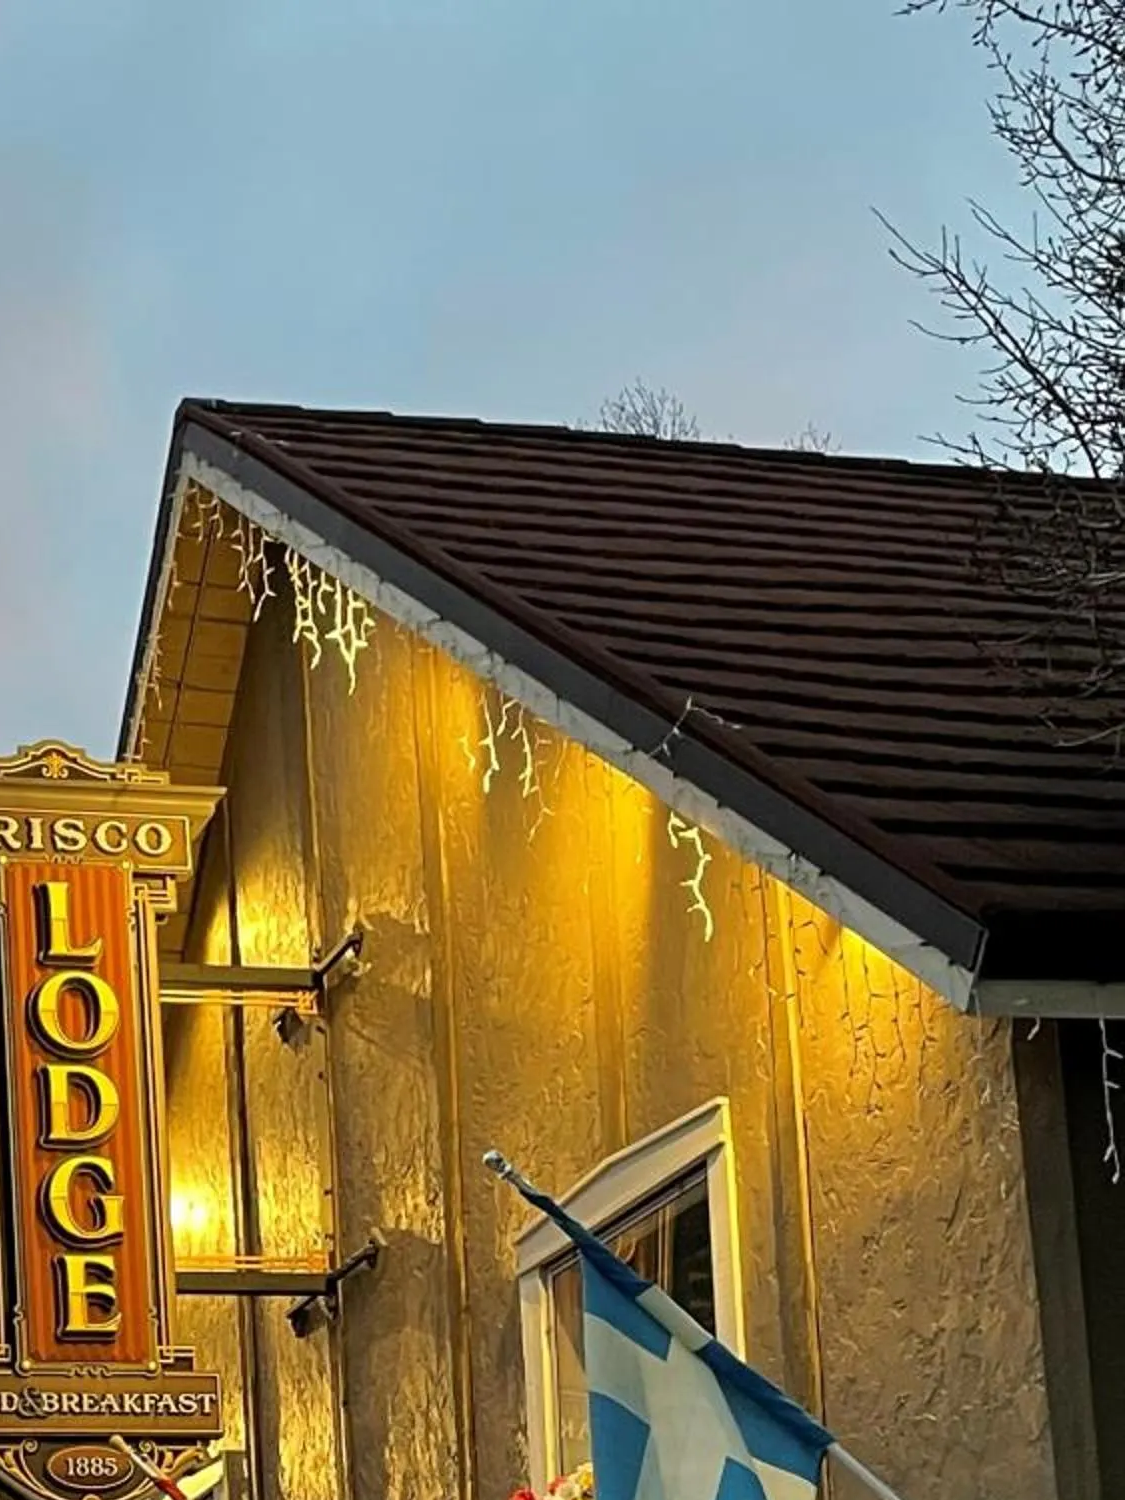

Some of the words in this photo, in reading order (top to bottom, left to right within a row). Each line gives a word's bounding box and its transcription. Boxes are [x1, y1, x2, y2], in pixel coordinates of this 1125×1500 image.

[29, 880, 125, 1338] LODGE
[43, 1393, 217, 1415] BREAKFAST
[64, 1456, 119, 1477] 1885
